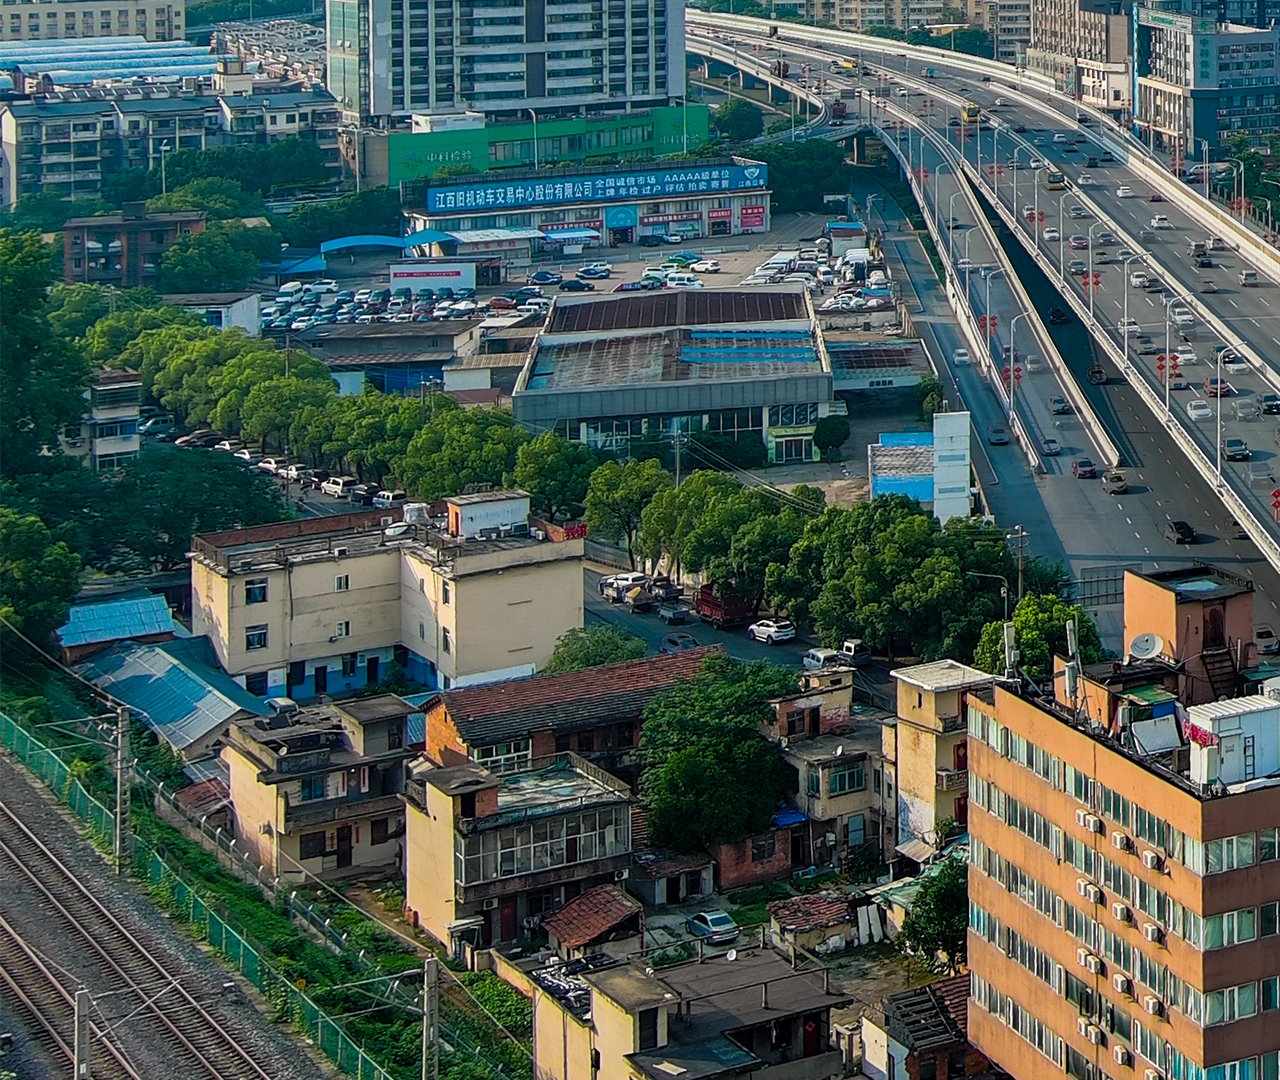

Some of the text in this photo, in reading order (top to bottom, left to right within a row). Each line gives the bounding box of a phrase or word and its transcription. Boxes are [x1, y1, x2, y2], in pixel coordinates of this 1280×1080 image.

[595, 169, 730, 188] 全国诚信市场 AAAAA级单位
[435, 181, 593, 208] 江西旧机动车交易中心股份有限公司
[594, 187, 616, 198] 上牌
[618, 185, 639, 196] 年检
[641, 184, 661, 195] 过户
[665, 182, 685, 193] 评估
